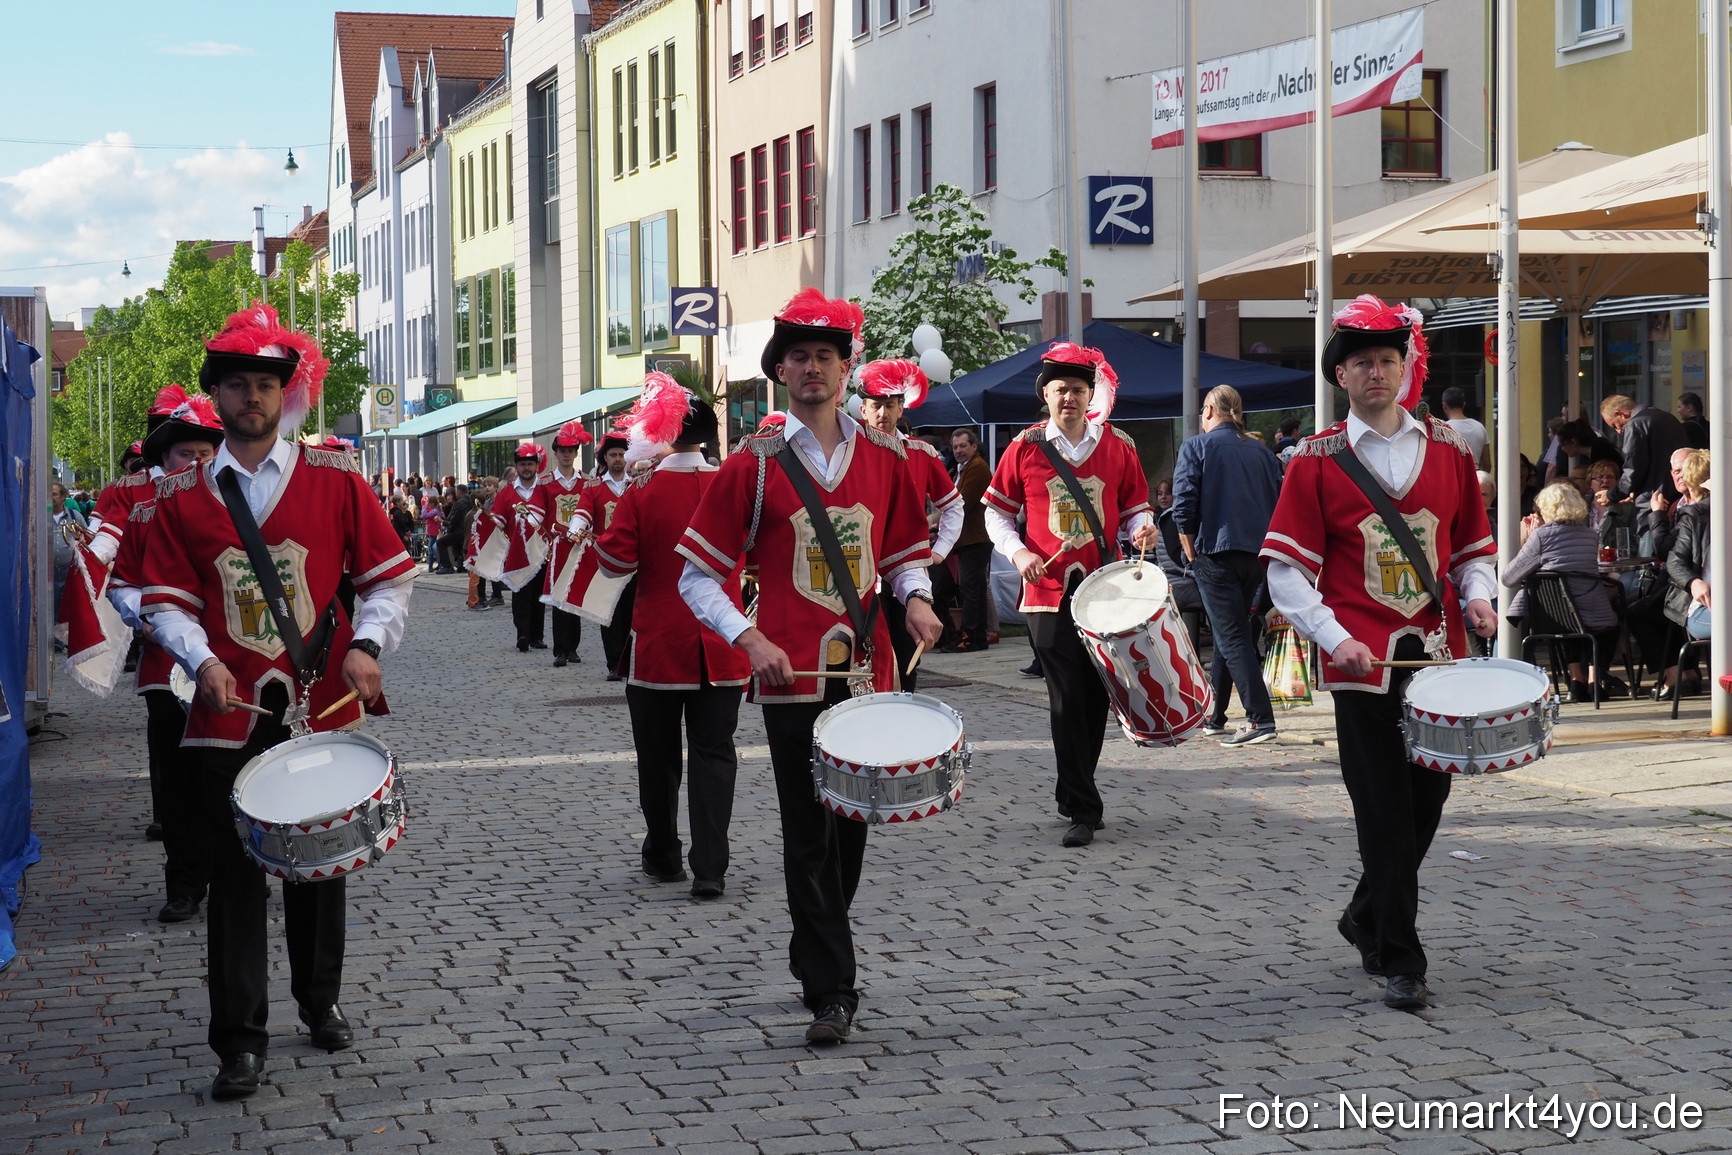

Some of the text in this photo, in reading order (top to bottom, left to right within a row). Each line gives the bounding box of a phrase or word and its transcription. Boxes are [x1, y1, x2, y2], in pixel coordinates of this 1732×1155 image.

[1154, 107, 1179, 121] Langer
[1242, 91, 1255, 106] mit
[1256, 89, 1269, 103] der
[1331, 60, 1350, 86] er
[1155, 79, 1173, 100] 13.
[1200, 67, 1228, 94] 2017
[1094, 184, 1150, 235] R.
[674, 292, 716, 329] R.
[381, 391, 390, 403] H
